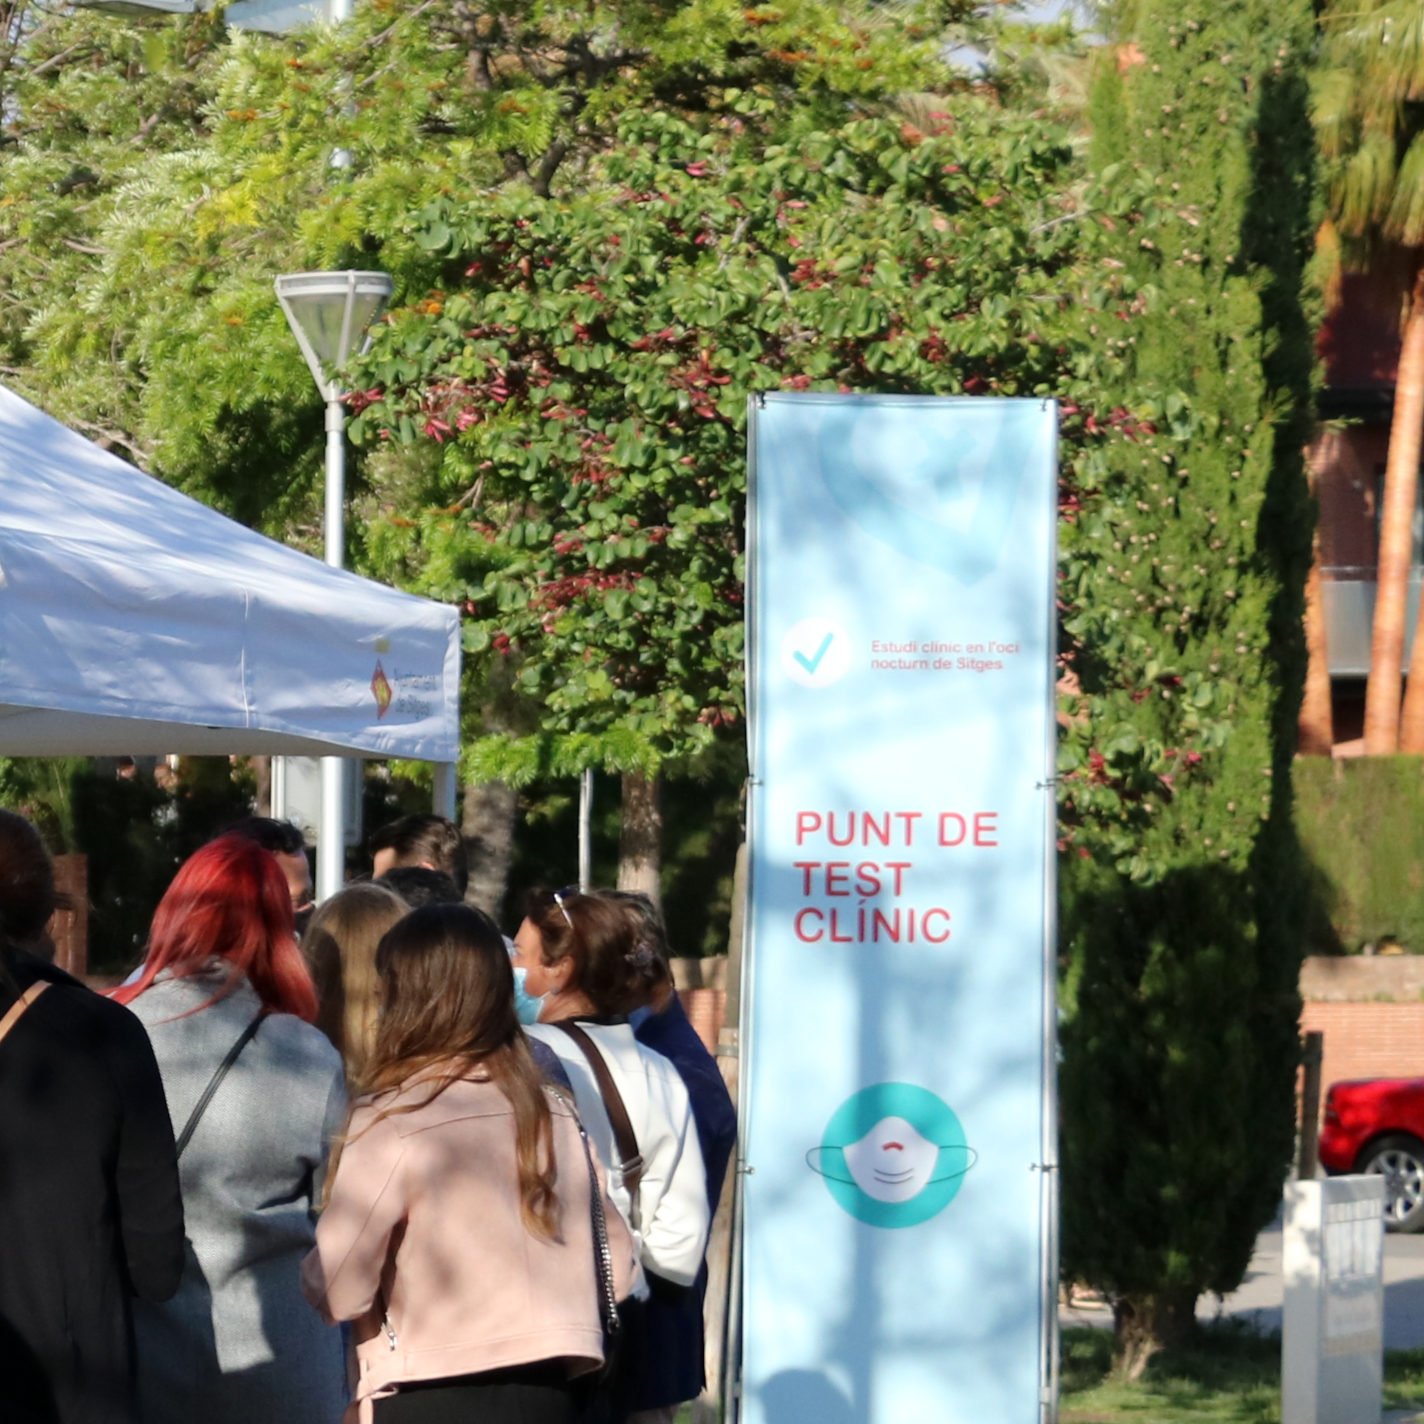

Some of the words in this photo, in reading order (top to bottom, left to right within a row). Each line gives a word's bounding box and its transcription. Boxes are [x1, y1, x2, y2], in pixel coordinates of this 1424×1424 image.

[871, 640, 918, 653] Estudi
[966, 643, 985, 653] en
[871, 657, 929, 669] nocturn
[932, 657, 952, 669] de
[956, 657, 1003, 672] Sitges
[795, 811, 922, 847] PUNT
[938, 812, 998, 847] DE
[793, 861, 912, 897] TEST
[793, 899, 951, 944] CLÍNIC
